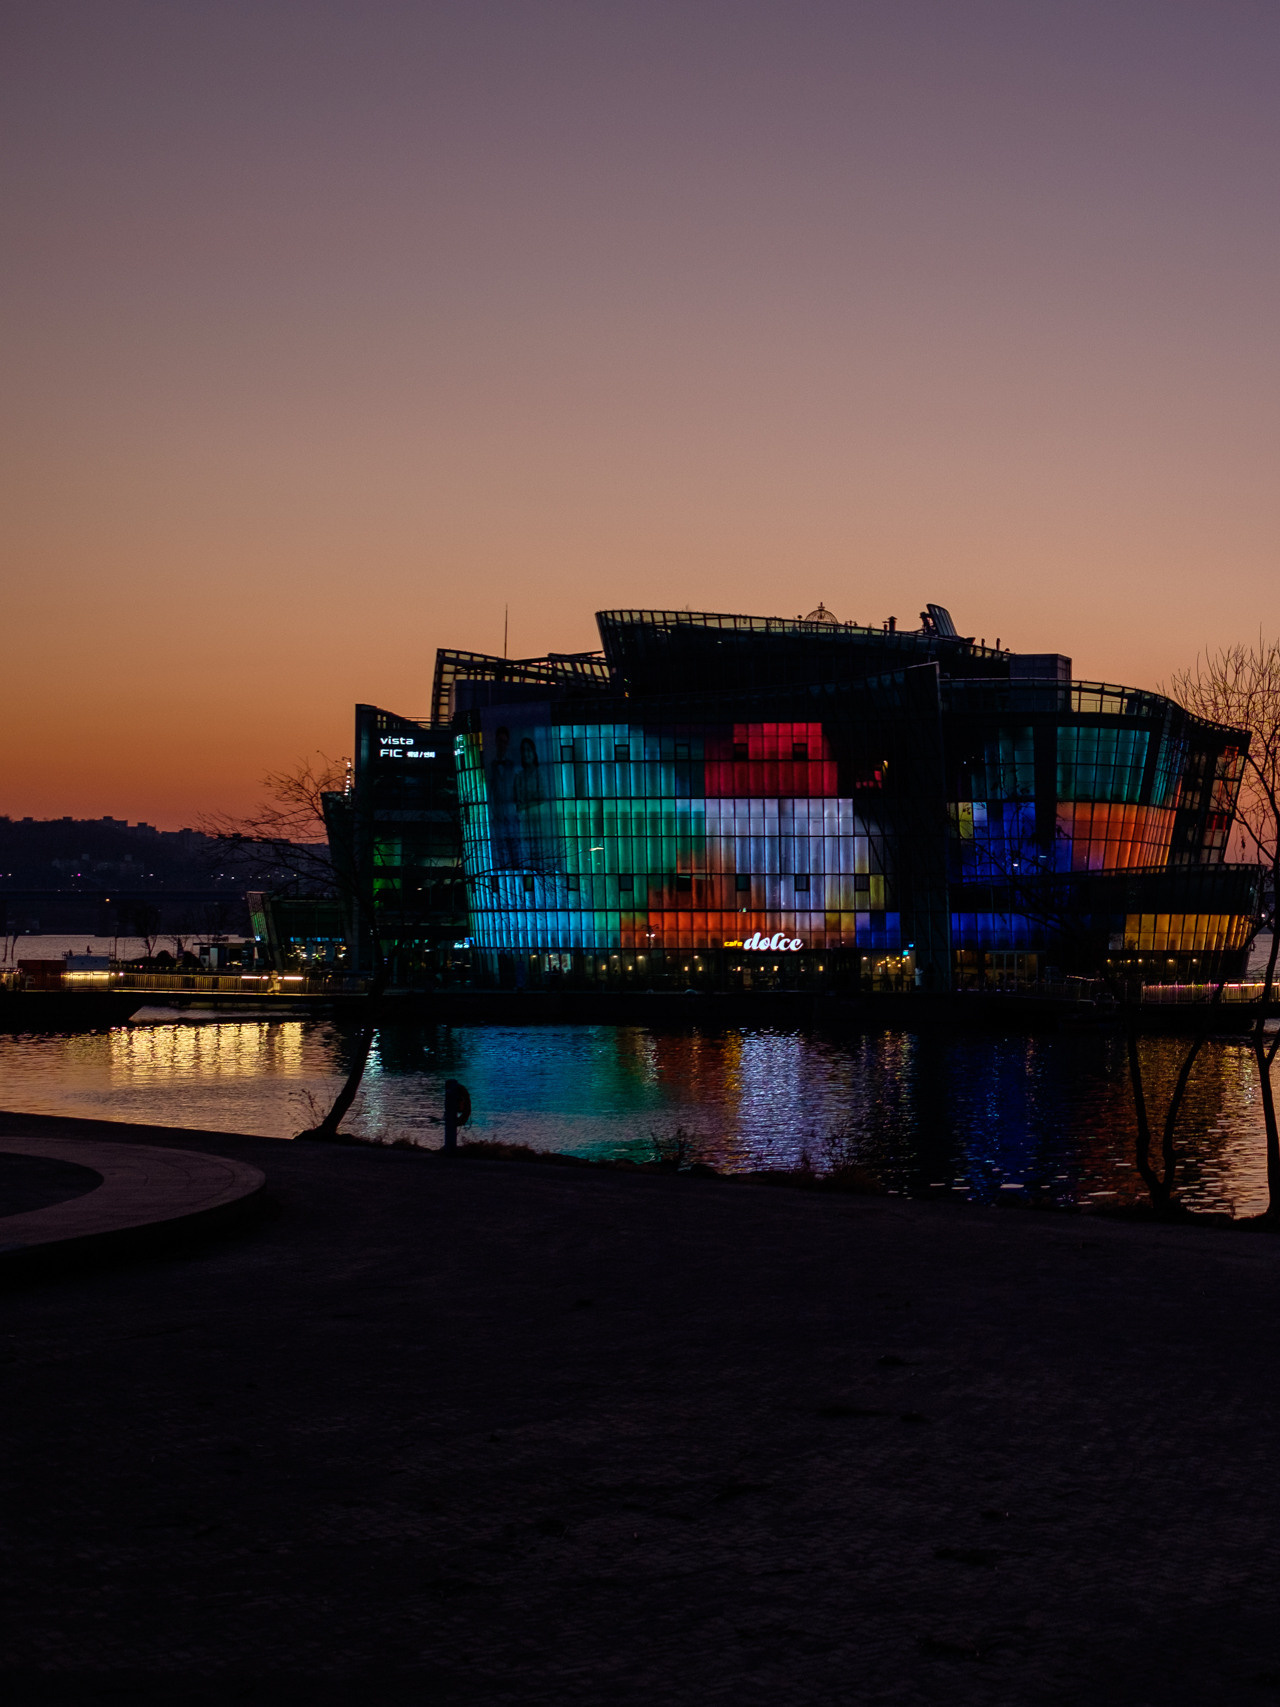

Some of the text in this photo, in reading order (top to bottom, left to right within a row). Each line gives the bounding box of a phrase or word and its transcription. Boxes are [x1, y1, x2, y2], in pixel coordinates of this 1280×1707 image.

[380, 736, 414, 745] vista
[380, 749, 403, 757] FIC
[743, 932, 804, 951] dolce
